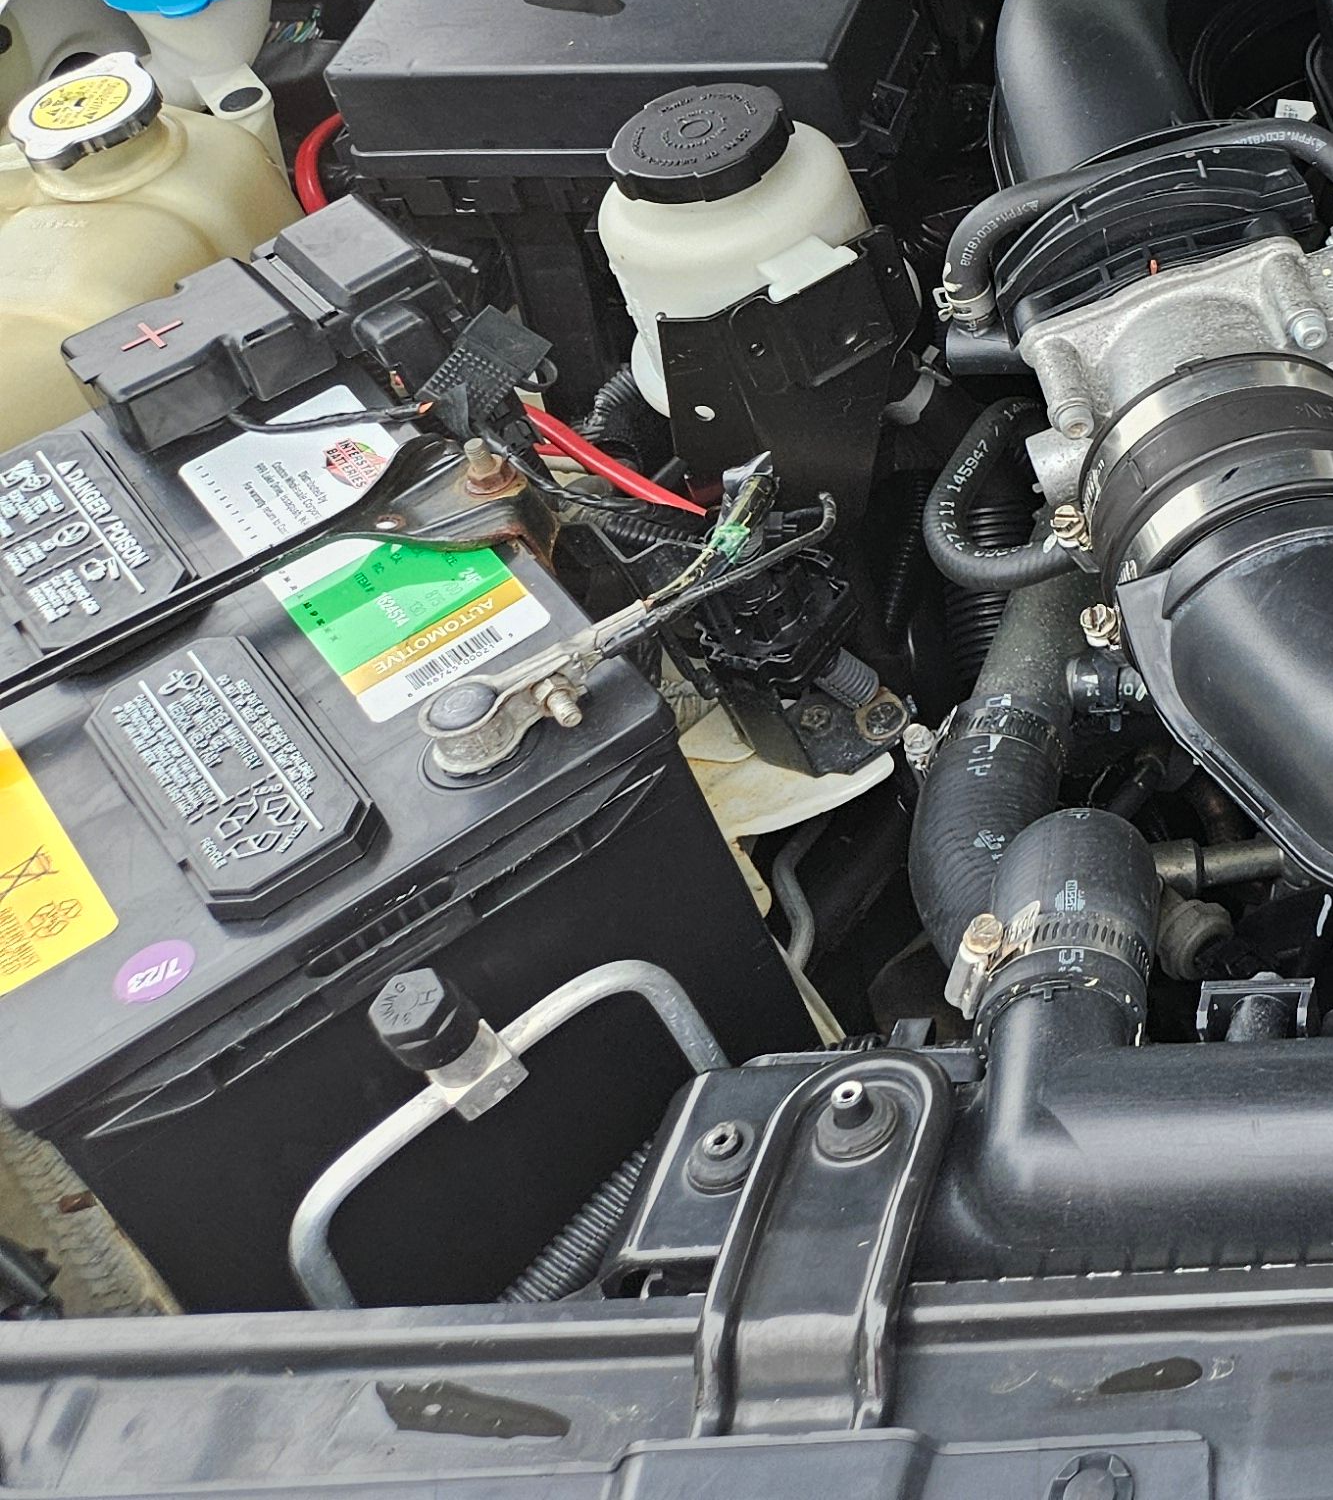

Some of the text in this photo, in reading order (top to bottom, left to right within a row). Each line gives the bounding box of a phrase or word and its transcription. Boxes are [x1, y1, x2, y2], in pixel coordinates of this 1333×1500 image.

[327, 447, 368, 490] BATTERIES
[337, 439, 380, 480] INTERSTAT
[946, 439, 989, 493] 145947
[372, 596, 494, 675] AUTOMOTIVE
[166, 701, 222, 769] MEDICAL HELP FAST
[179, 692, 203, 714] WITH
[209, 734, 231, 753] GET
[193, 685, 262, 770] FLUSH EYES IMMEDIATELY
[127, 956, 183, 995] 7/23
